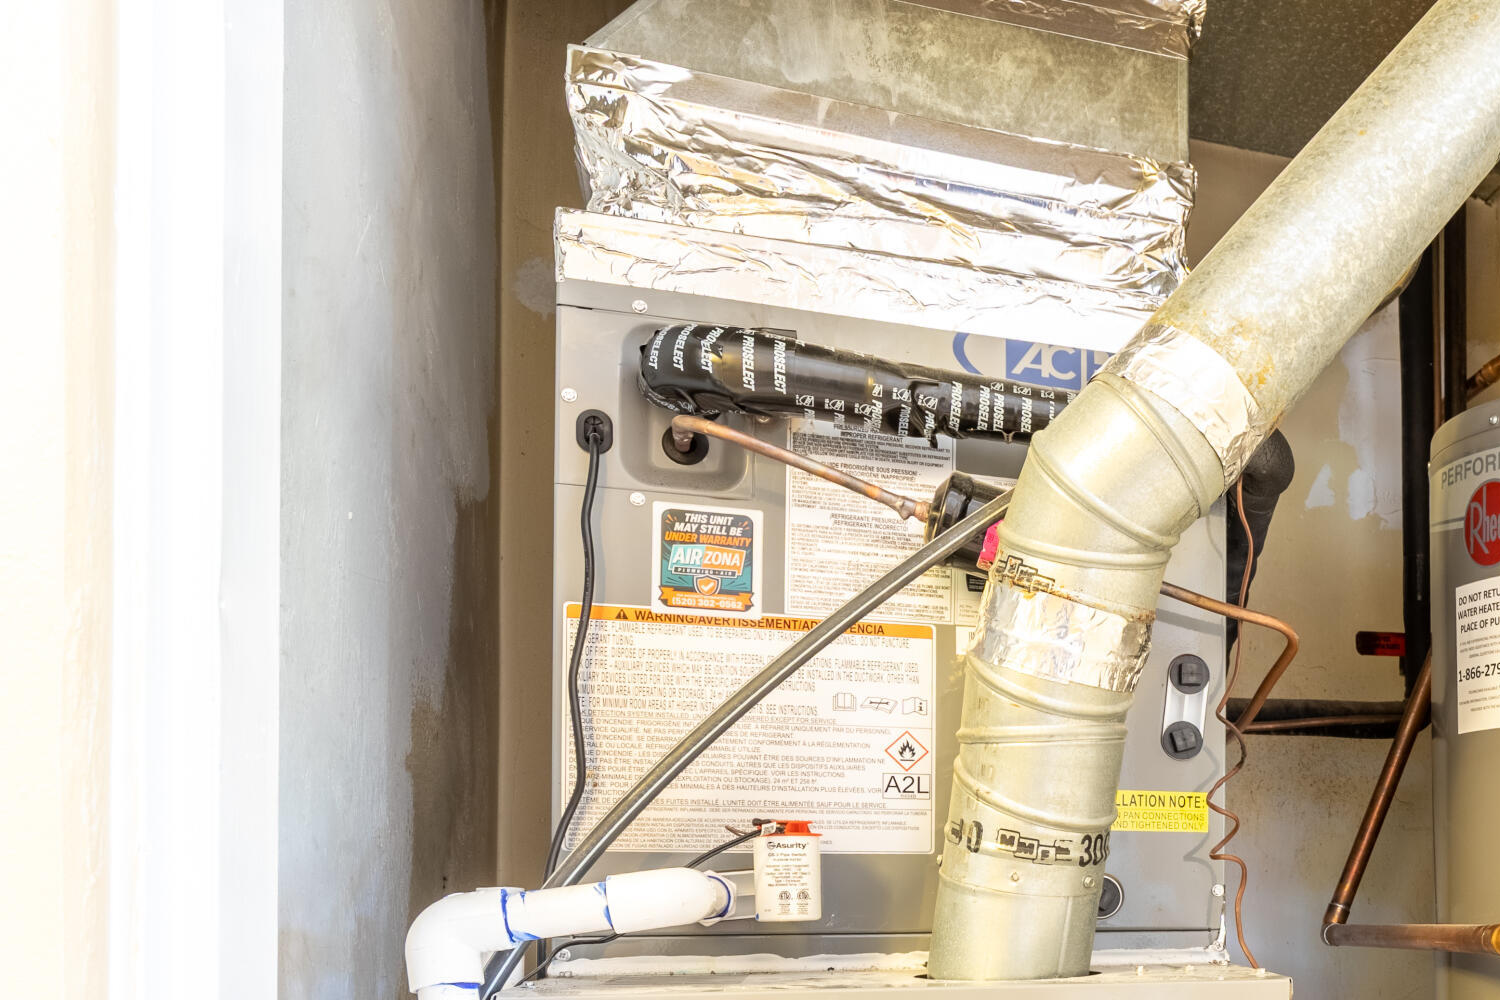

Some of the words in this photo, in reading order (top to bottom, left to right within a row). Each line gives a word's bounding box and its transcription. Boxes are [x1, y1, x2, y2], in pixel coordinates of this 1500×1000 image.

[673, 323, 697, 371] PROSELECT
[742, 334, 755, 391] PROSELECT
[773, 339, 787, 394] PROSELECT
[1011, 343, 1078, 382] AC
[868, 434, 903, 442] REFRIGERANT
[685, 513, 708, 524] THIS
[709, 515, 734, 526] UNIT
[674, 522, 697, 532] MAY
[700, 524, 728, 535] STILL
[729, 527, 743, 536] BE
[665, 531, 698, 542] UNDER
[700, 534, 752, 547] WARRANTY
[1459, 596, 1467, 606] DO
[1469, 592, 1481, 603] NOT
[1458, 607, 1477, 620] WATER
[1460, 621, 1478, 634] PLACE
[1479, 619, 1488, 629] OF
[885, 775, 929, 794] A2L
[1170, 795, 1205, 808] NOTE:
[1142, 812, 1204, 821] CONNECTIONS
[1131, 821, 1179, 830] TIGHTENED
